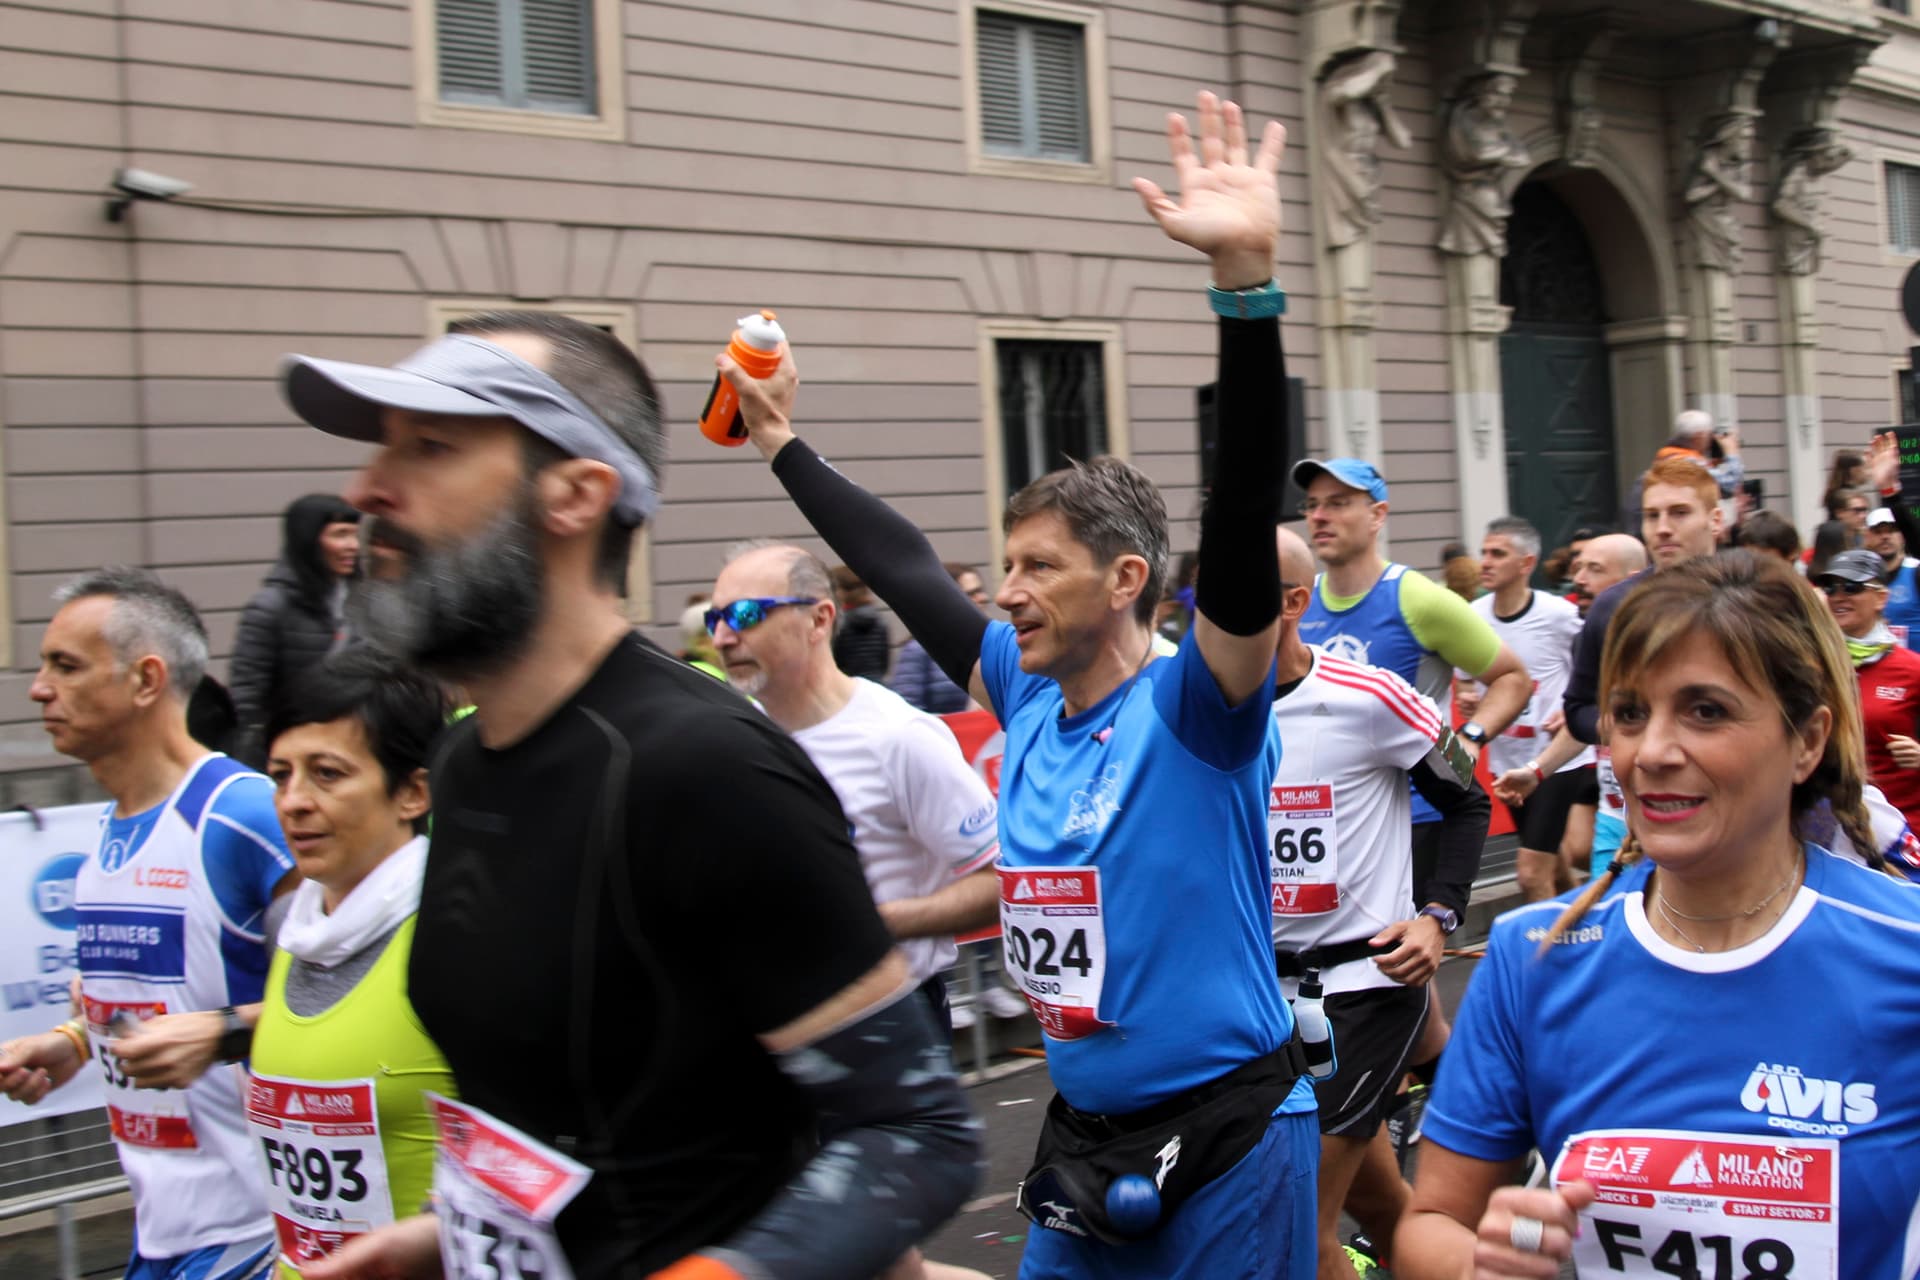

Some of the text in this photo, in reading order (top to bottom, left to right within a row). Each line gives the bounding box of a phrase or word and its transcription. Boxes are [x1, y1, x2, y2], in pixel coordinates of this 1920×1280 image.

[1281, 790, 1319, 801] MILANO
[1269, 827, 1326, 864] 66
[1036, 877, 1082, 890] MILANO
[1271, 885, 1300, 907] A7
[97, 924, 161, 945] RUNNERS
[303, 1093, 354, 1107] MILANO
[1740, 1070, 1878, 1124] AVIS
[1767, 1115, 1849, 1136] OGGIONO
[260, 1136, 368, 1203] F893
[1583, 1146, 1651, 1174] EA7
[1718, 1152, 1804, 1178] MILANO
[1717, 1172, 1804, 1190] MARATHON
[1631, 1194, 1640, 1205] 6
[1732, 1203, 1826, 1220] START SECTOR: 7
[1593, 1218, 1795, 1280] F418
